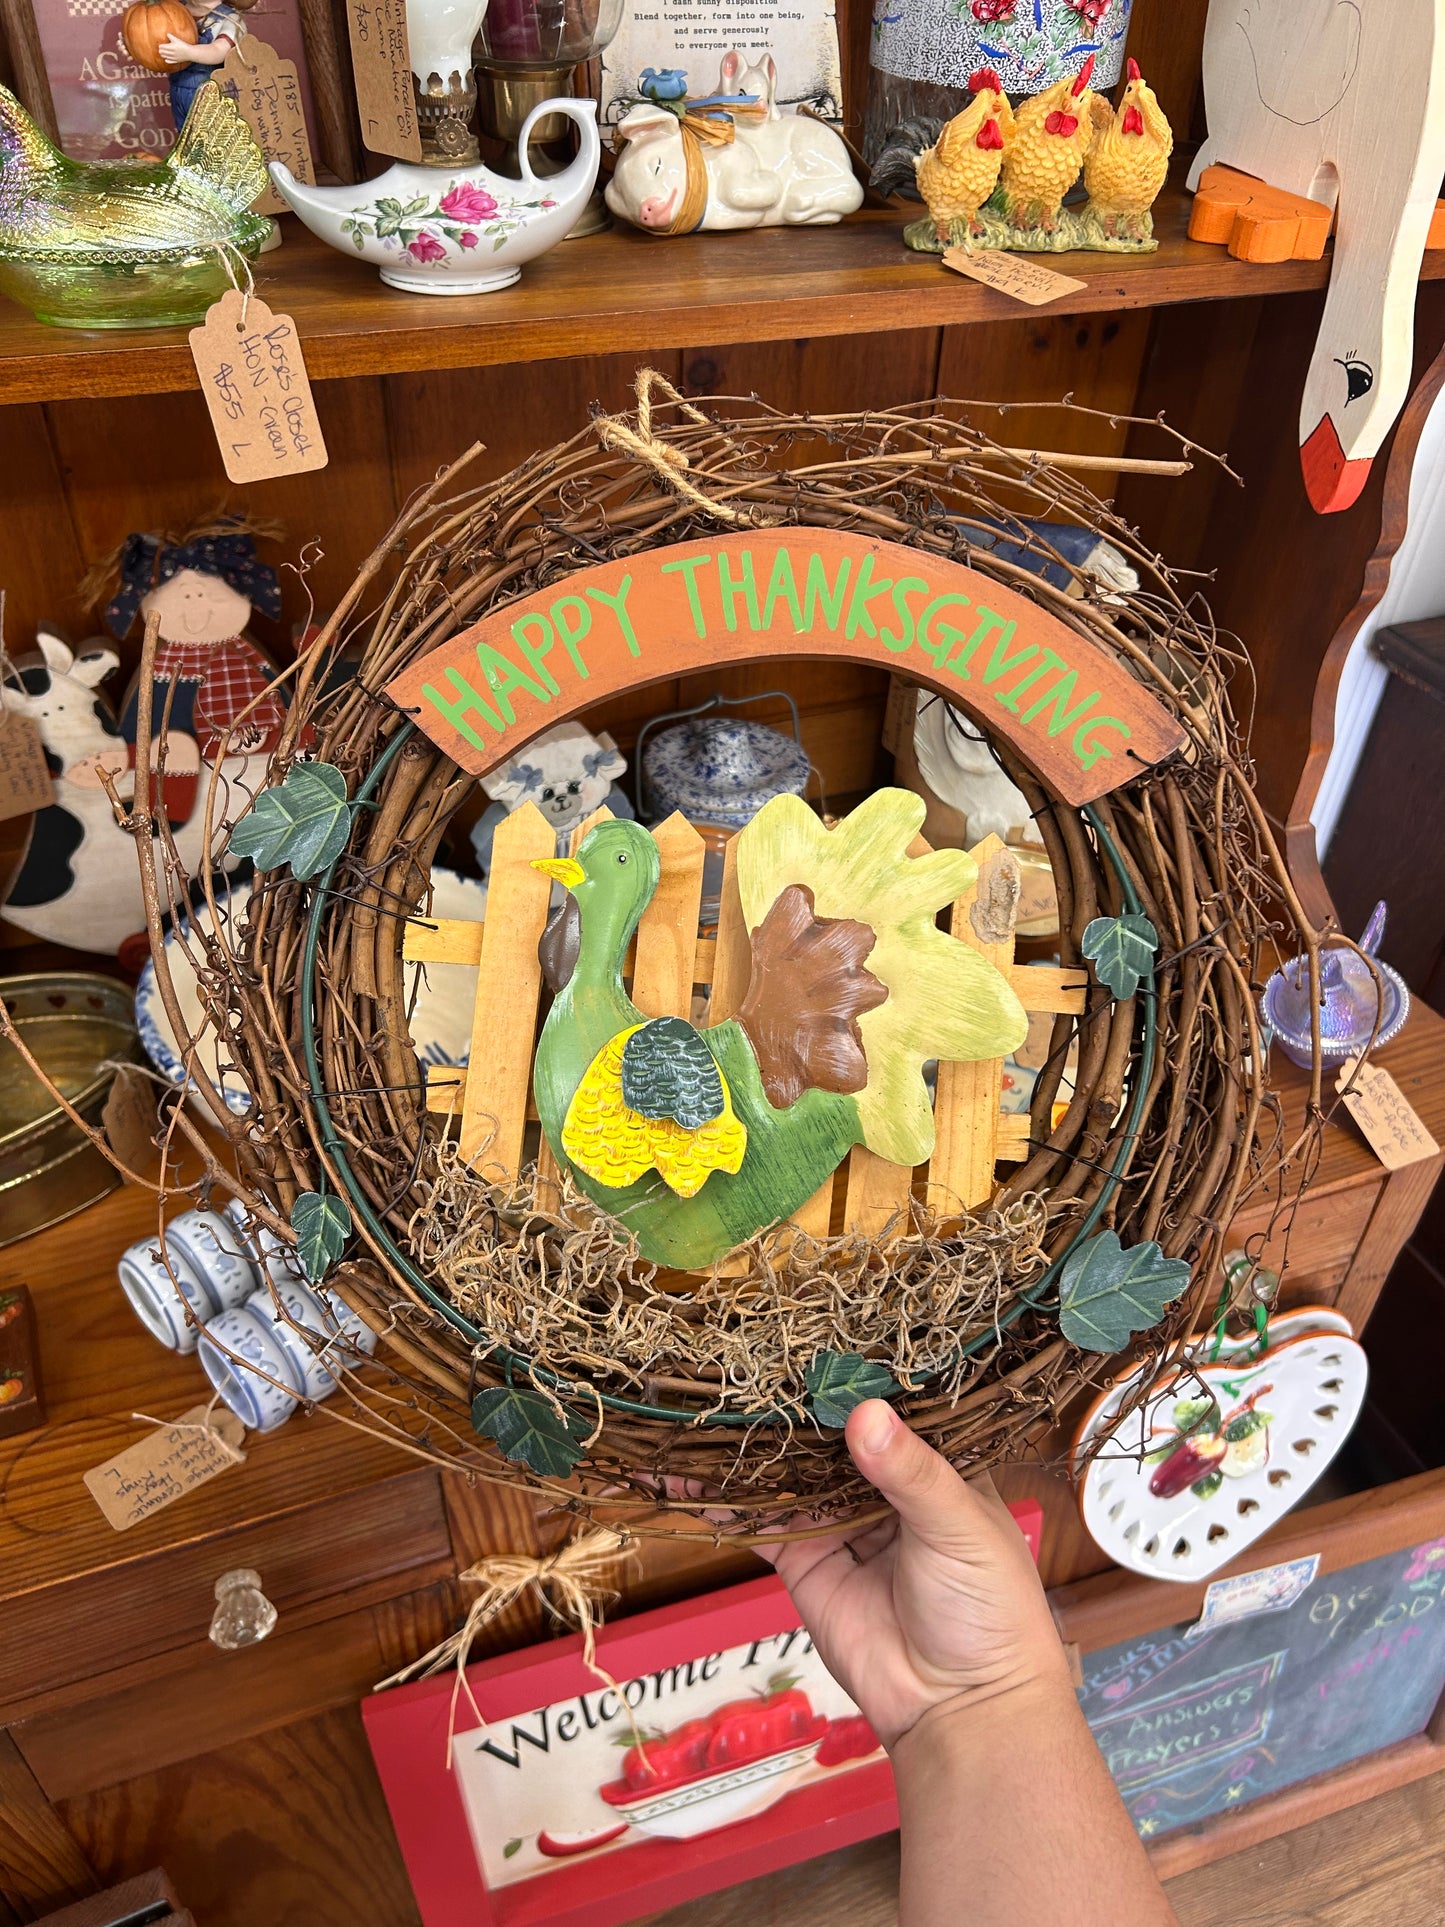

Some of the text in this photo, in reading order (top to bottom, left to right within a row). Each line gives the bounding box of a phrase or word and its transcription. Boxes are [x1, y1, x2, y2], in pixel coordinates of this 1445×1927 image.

[354, 3, 370, 42] $20
[375, 7, 386, 59] Lamp
[664, 12, 707, 21] together,
[712, 12, 731, 20] form
[778, 11, 805, 20] being,
[722, 26, 769, 35] generously
[79, 57, 98, 80] A
[689, 42, 728, 50] everyone
[750, 40, 774, 48] meet.
[264, 77, 283, 143] Denim
[278, 74, 300, 116] 1985
[401, 69, 413, 135] Porcelain
[257, 116, 270, 144] with
[397, 115, 408, 140] Oil
[239, 334, 269, 387] HON
[213, 363, 251, 457] $55 L
[263, 324, 312, 457] Rose's Closet
[422, 548, 1131, 770] HAPPY THANKSGIVING
[116, 1470, 155, 1497] Rings
[133, 1440, 216, 1505] Blue Heart
[476, 1651, 723, 1769] Welcome
[1127, 1683, 1256, 1741] Answers
